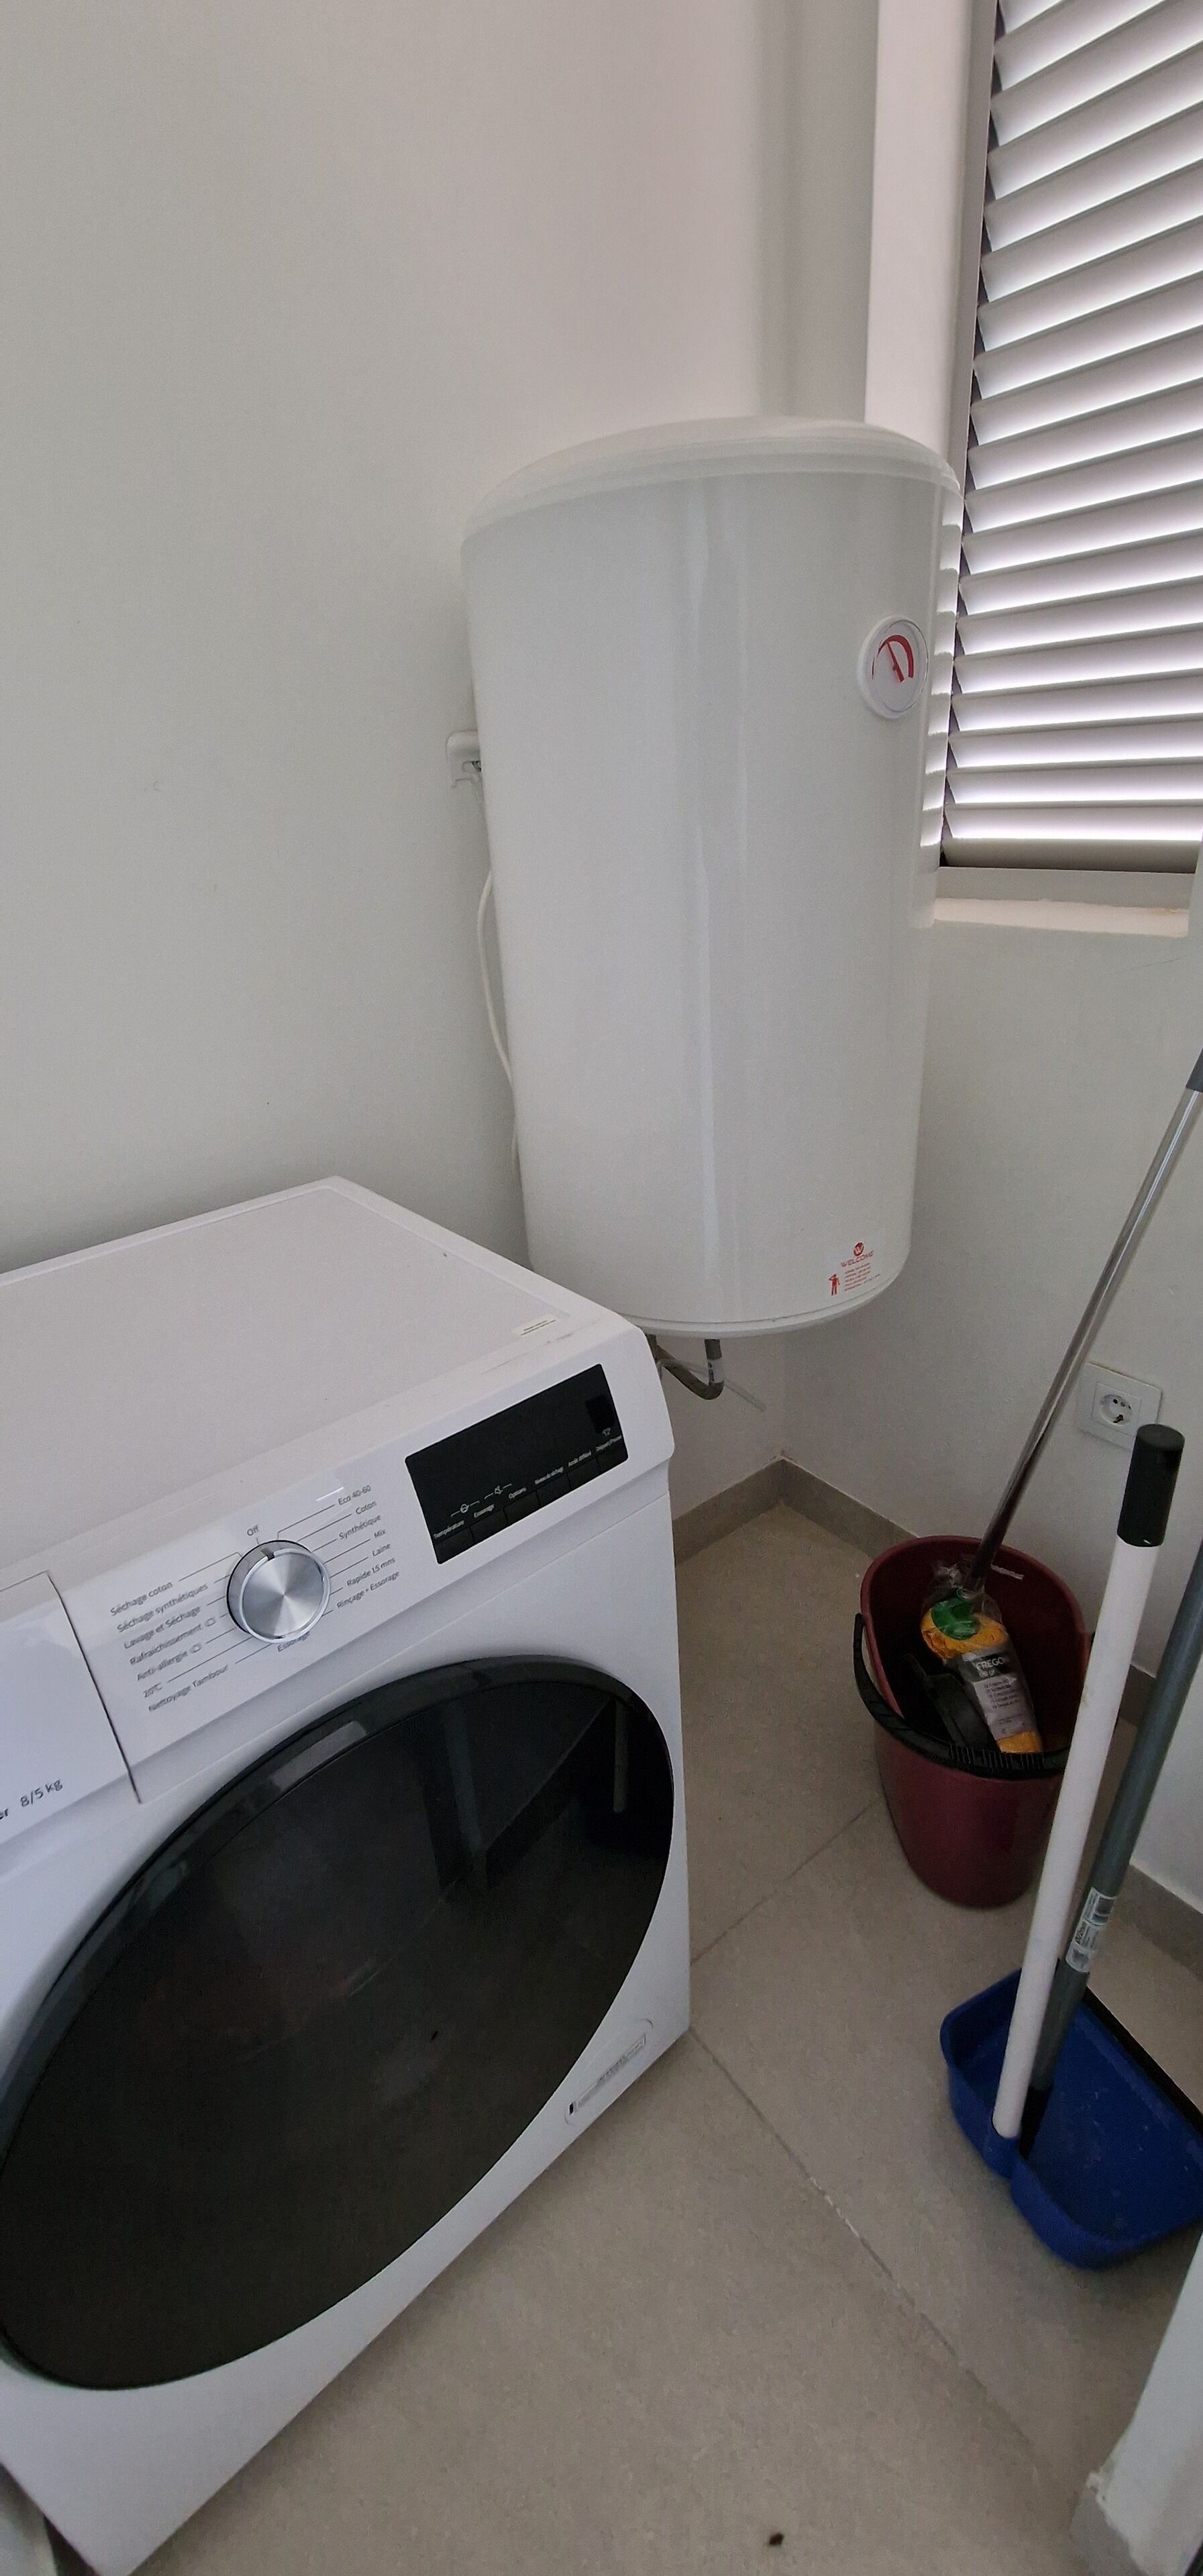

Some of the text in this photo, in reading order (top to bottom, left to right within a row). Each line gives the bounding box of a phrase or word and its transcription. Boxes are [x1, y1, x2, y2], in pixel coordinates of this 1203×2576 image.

[841, 1250, 874, 1267] WELCOME
[338, 1485, 371, 1505] Eco 40-60
[356, 1501, 376, 1515] Coton
[247, 1525, 259, 1536] Off
[339, 1515, 381, 1540] Synthétique
[374, 1528, 386, 1538] Mix
[372, 1543, 391, 1557] Laine
[346, 1570, 371, 1587] Rapide
[372, 1564, 380, 1573] 15
[110, 1582, 173, 1616] Séchage coton
[337, 1589, 364, 1609] Rinçage
[370, 1571, 400, 1591] Essorage
[117, 1584, 209, 1633] Séchage synthétiques
[124, 1606, 201, 1649] Lavage et Séchage
[137, 1651, 188, 1681] Anti-allergie
[143, 1682, 163, 1698] 20°C
[148, 1664, 228, 1711] Nettoyage Tambour
[20, 1787, 44, 1807] 8/5
[45, 1780, 63, 1793] kg
